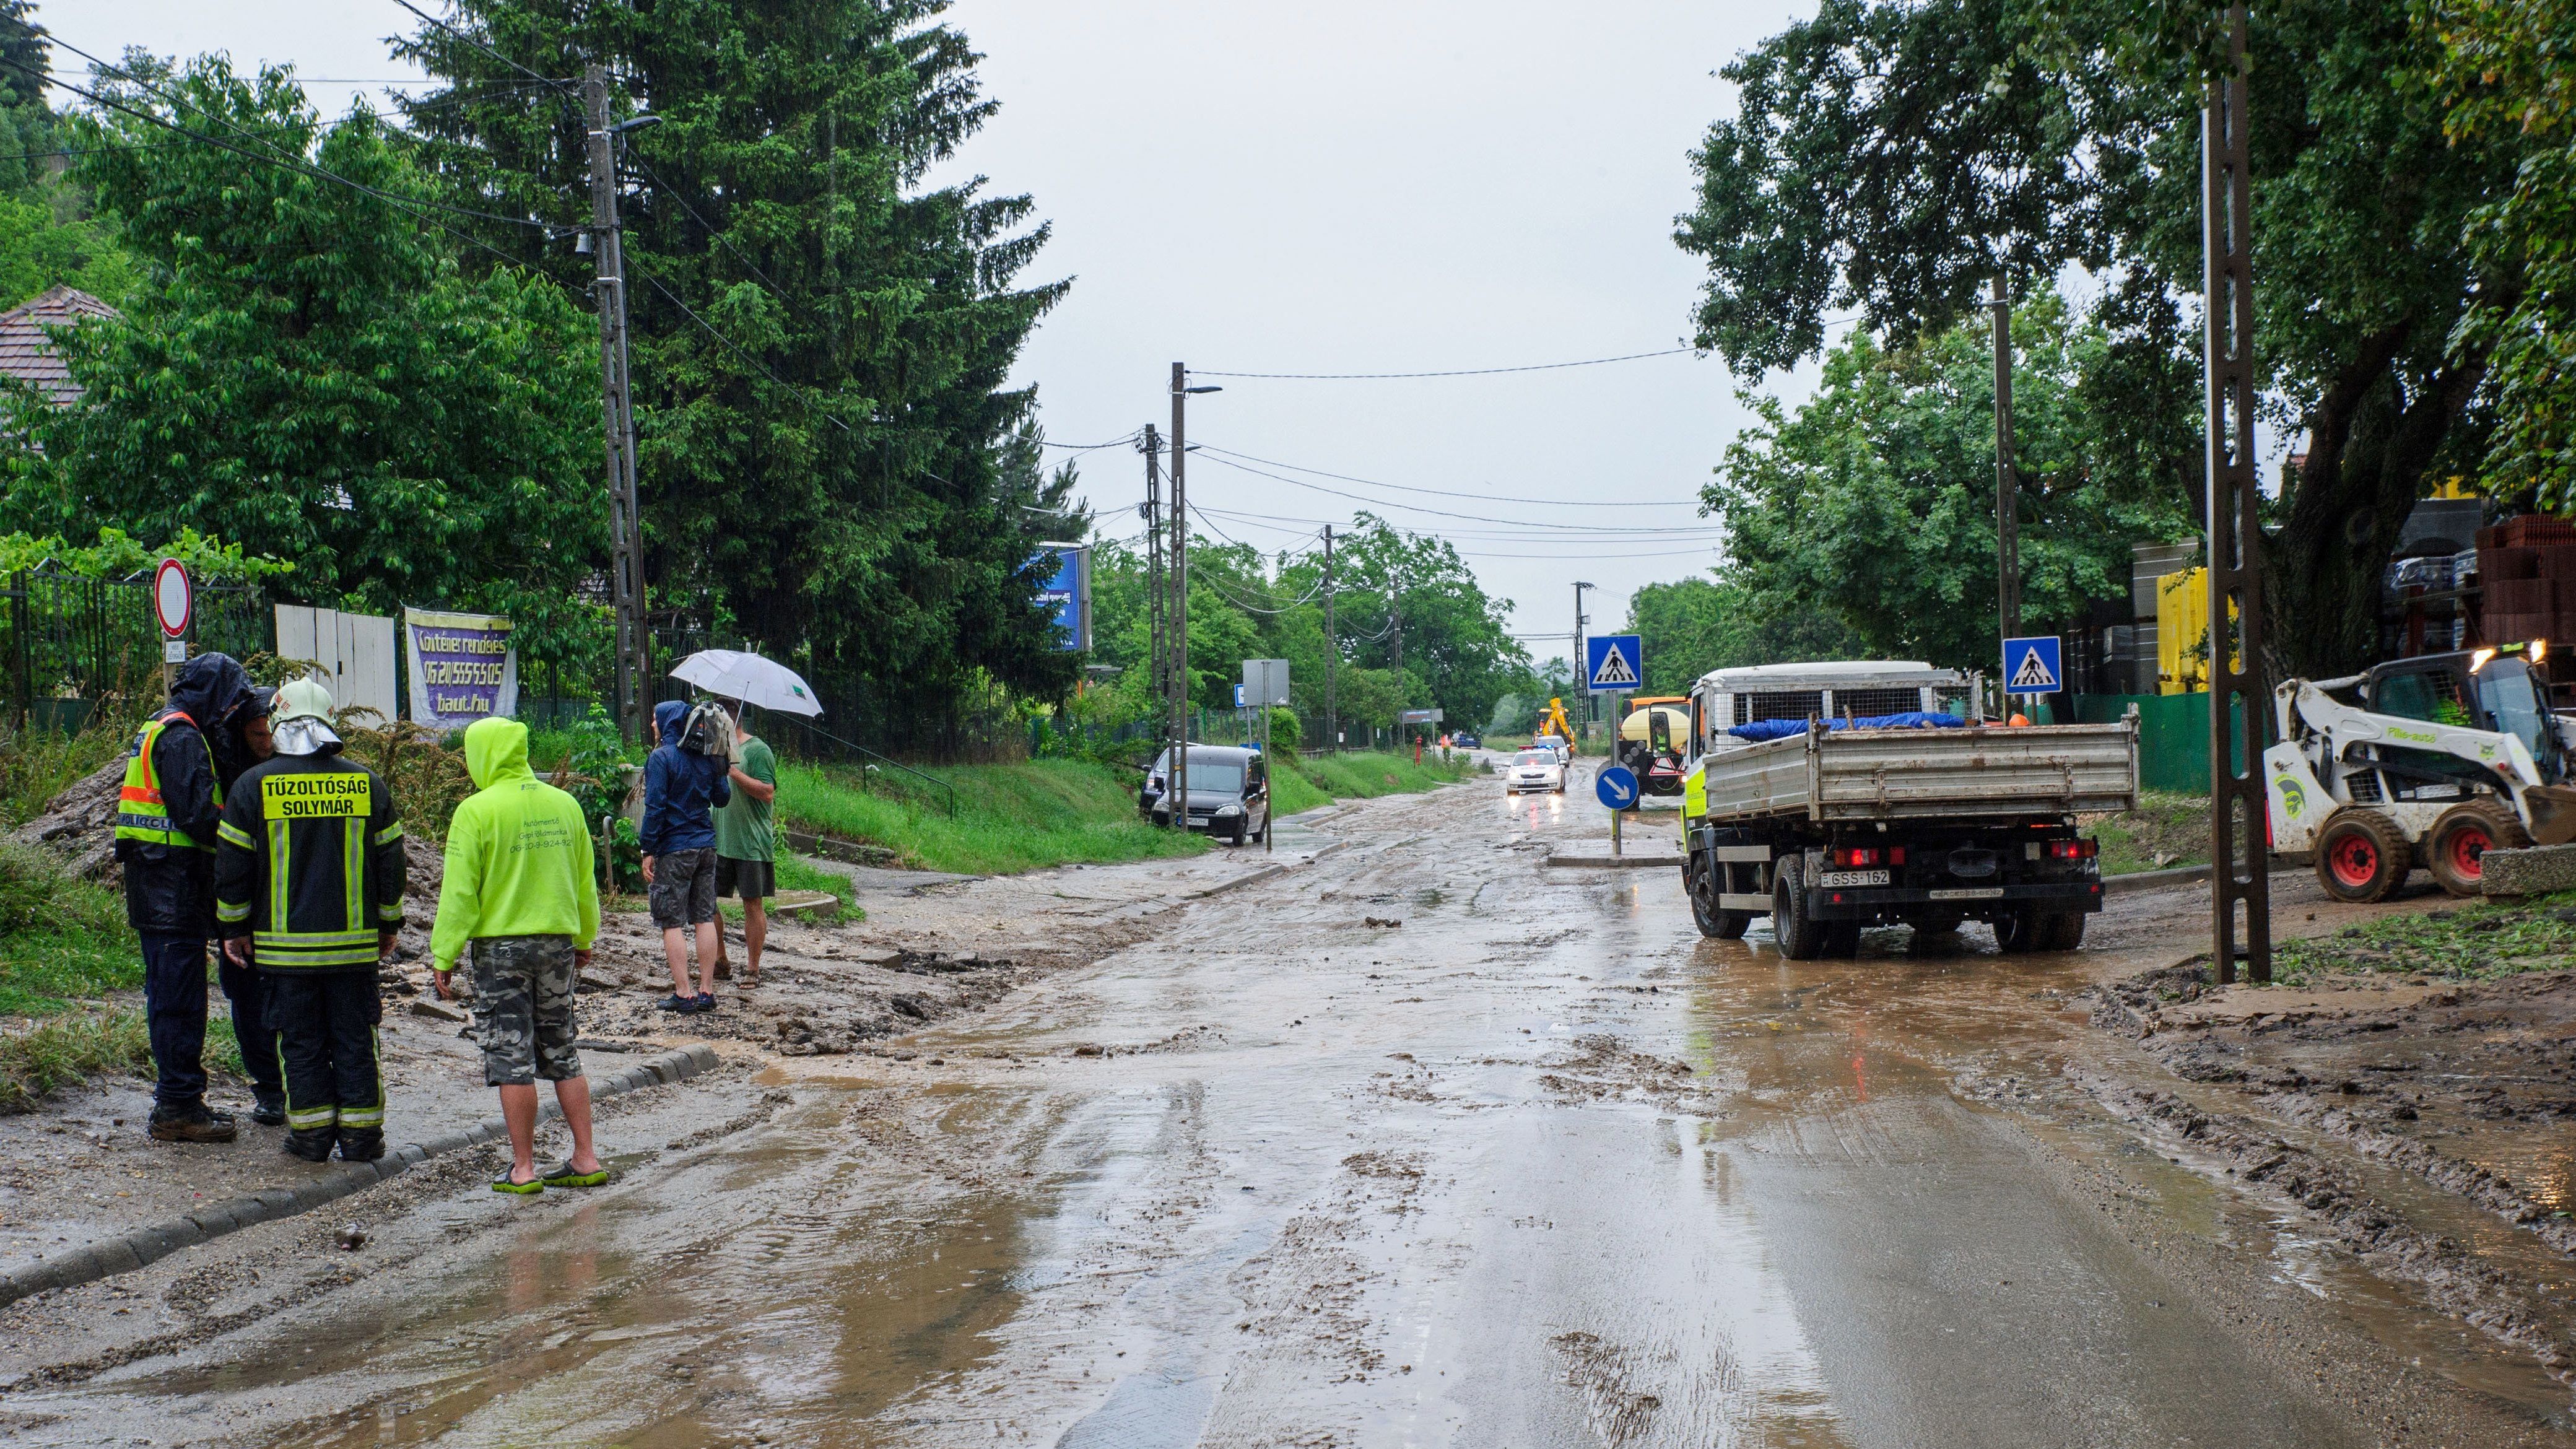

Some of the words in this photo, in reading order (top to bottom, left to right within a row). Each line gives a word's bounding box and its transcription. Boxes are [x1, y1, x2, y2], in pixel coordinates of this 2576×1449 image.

[437, 693, 489, 712] baut.hu
[266, 775, 367, 796] TŰZOLTÓSÁG
[282, 795, 354, 816] SOLYMÁR
[1832, 871, 1888, 886] GSS-162
[1931, 889, 2002, 898] MERCEDES-BENZ
